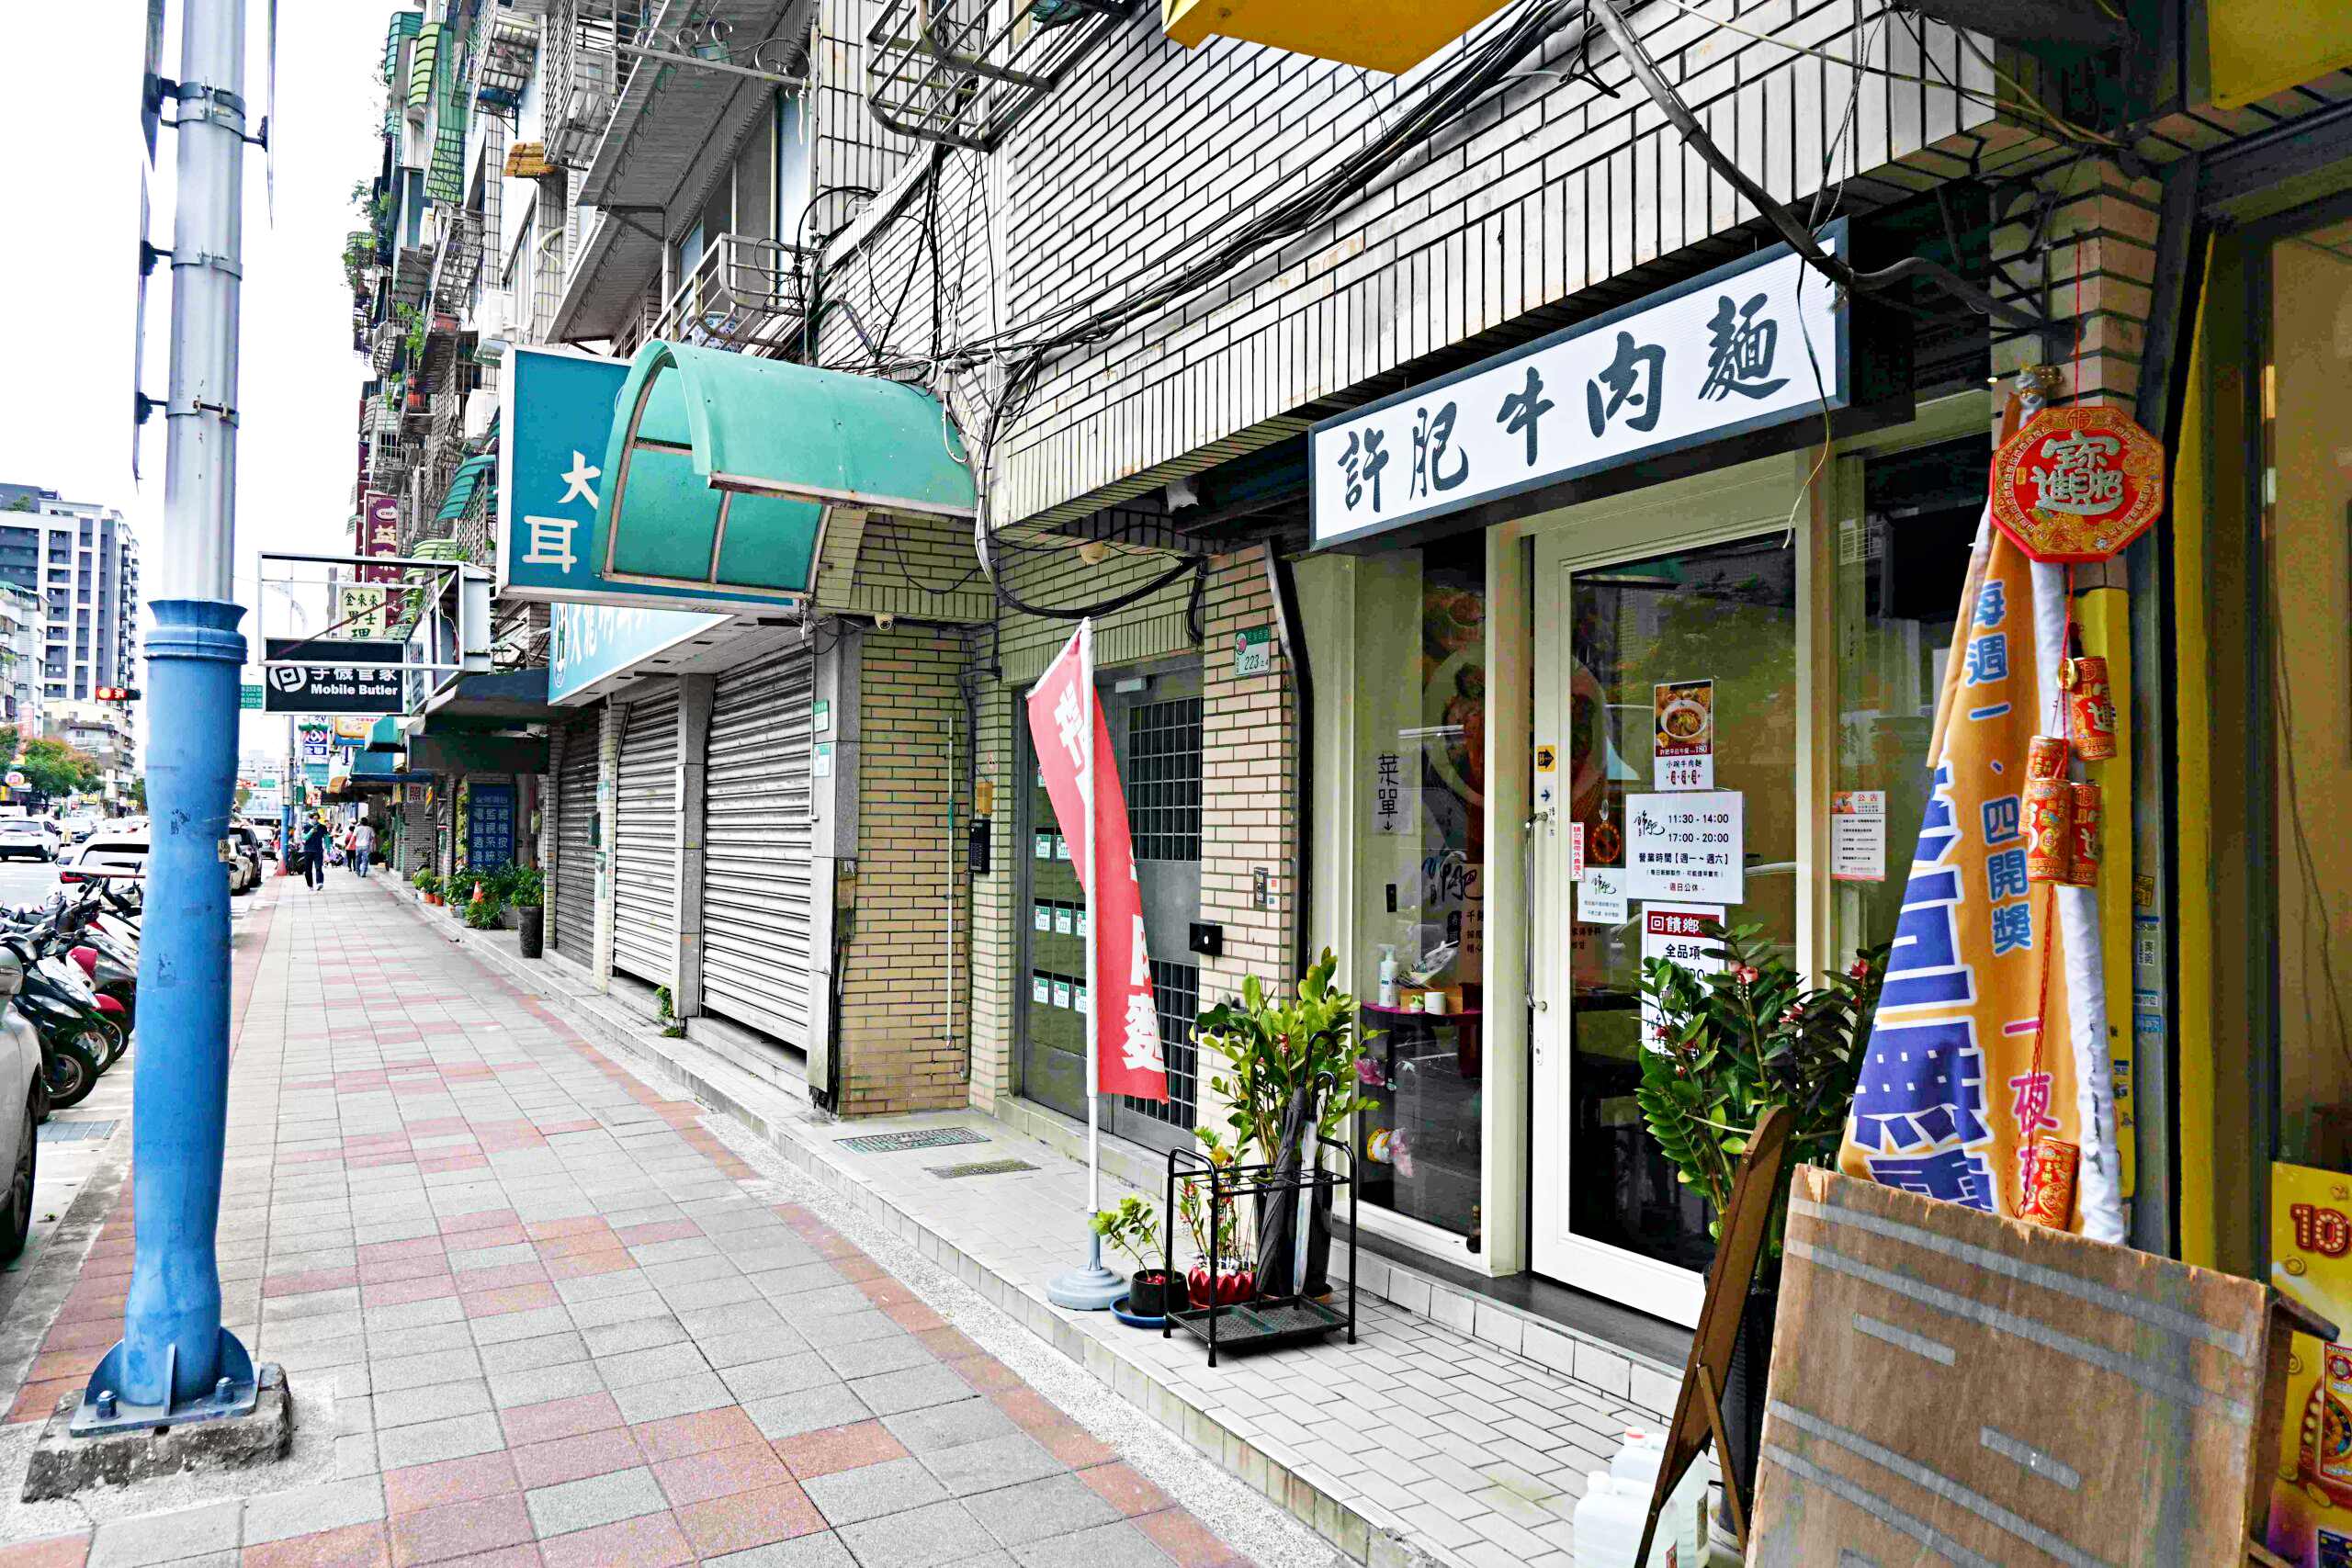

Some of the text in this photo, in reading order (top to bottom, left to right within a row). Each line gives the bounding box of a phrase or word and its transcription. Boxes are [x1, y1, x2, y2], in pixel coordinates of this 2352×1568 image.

[1337, 292, 1790, 513] 許肥牛肉麵
[556, 449, 601, 510] 大
[522, 514, 579, 574] 耳
[1245, 655, 1259, 670] 223
[311, 684, 398, 695] Mobile Butler
[1378, 752, 1399, 818] 菜單
[1668, 815, 1694, 824] 11:30
[1703, 814, 1729, 823] 14:00
[1668, 833, 1694, 842] 17:00
[1702, 833, 1729, 842] 20:00
[1651, 916, 1702, 934] 回饋鄉
[1665, 943, 1701, 961] 全品項
